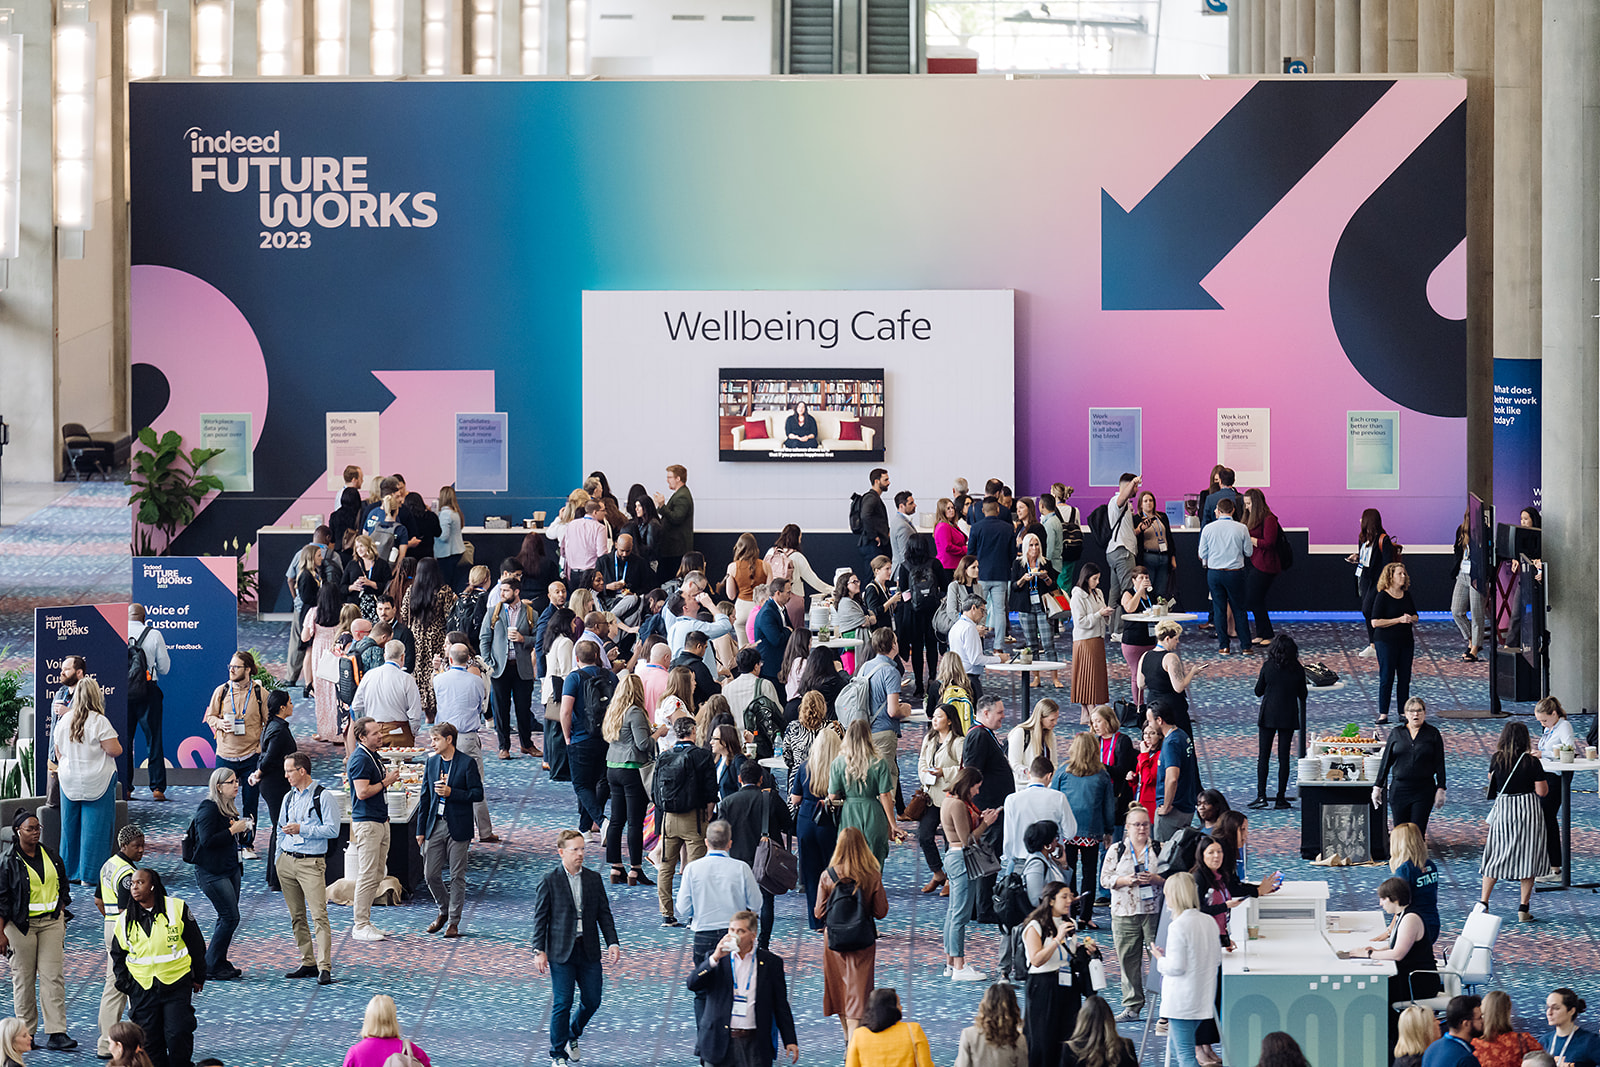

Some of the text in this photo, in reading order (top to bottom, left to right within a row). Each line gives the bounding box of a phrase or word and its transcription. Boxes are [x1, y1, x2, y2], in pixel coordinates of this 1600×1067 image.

[184, 127, 280, 153] indeed
[192, 156, 368, 193] FUTURE
[259, 192, 439, 229] WORKS
[259, 231, 312, 249] 2023
[663, 309, 932, 349] Wellbeing Cafe
[1510, 385, 1533, 395] does
[1513, 396, 1538, 405] work
[1506, 405, 1522, 415] like
[143, 569, 179, 578] FUTURE
[156, 576, 193, 585] WORKS
[144, 604, 190, 615] Voice of
[45, 619, 77, 630] FUTURE
[144, 619, 200, 629] Customer
[57, 626, 89, 636] WORKS
